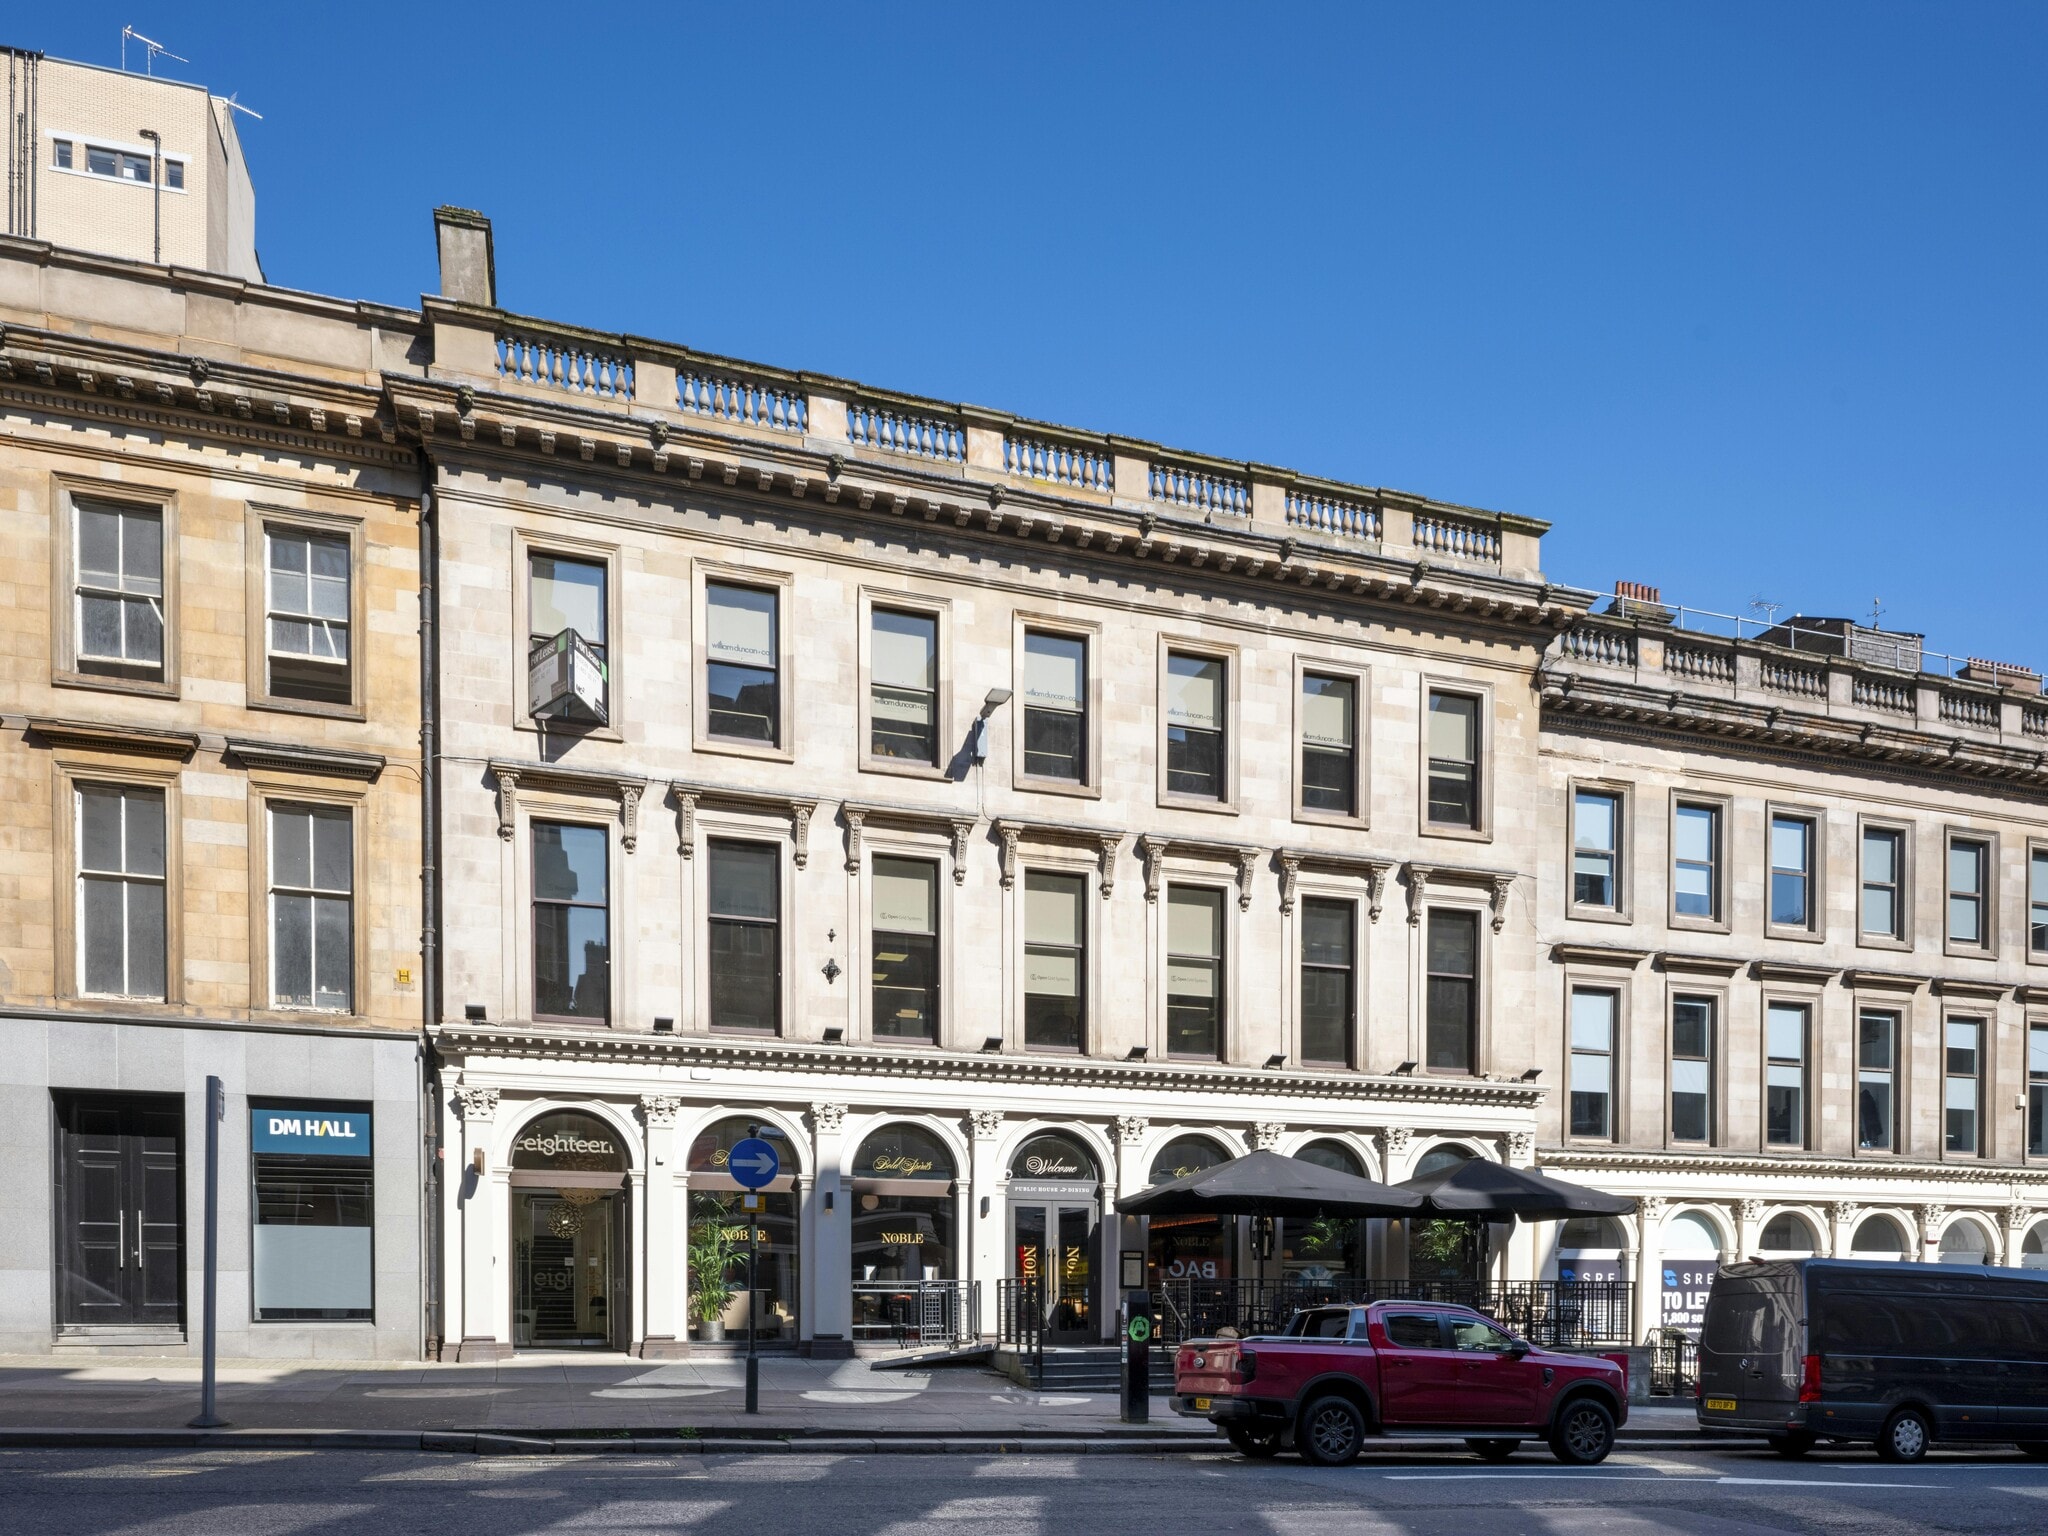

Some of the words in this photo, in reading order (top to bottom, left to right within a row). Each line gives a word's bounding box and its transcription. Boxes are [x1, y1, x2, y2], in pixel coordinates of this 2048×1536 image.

[575, 635, 586, 652] For
[530, 652, 539, 667] For
[540, 643, 556, 660] Lease
[398, 970, 410, 982] H
[269, 1118, 301, 1136] DM
[305, 1120, 356, 1137] HALL
[524, 1133, 615, 1156] eighteen
[1026, 1155, 1078, 1175] Welcome
[720, 1229, 766, 1241] NOBE
[881, 1232, 924, 1244] NOBLE
[1172, 1236, 1210, 1247] NOBLE
[1683, 1272, 1714, 1285] SRE
[1662, 1291, 1683, 1310] TO
[1662, 1311, 1690, 1326] 1,800
